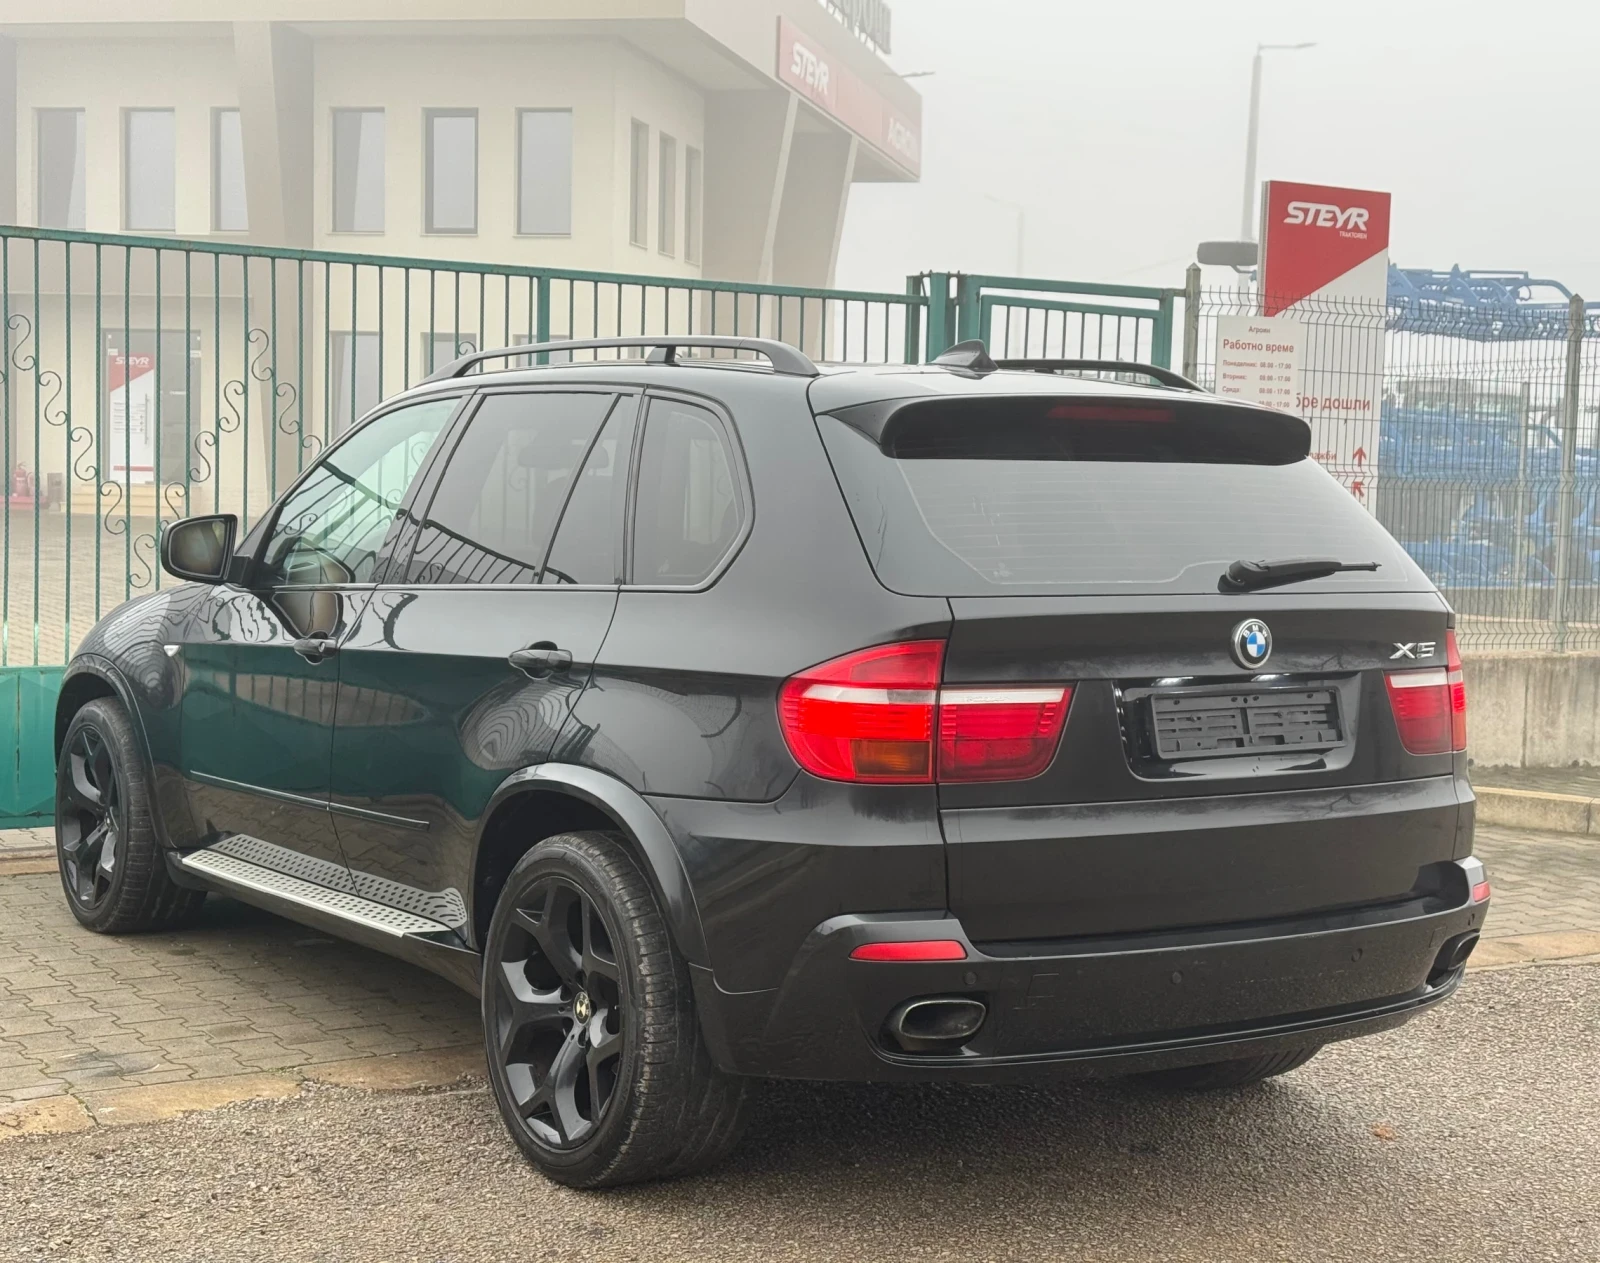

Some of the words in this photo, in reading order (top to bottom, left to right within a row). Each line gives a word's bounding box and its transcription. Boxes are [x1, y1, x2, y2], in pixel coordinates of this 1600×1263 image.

[790, 41, 830, 95] STEYR
[1283, 201, 1370, 231] STEYR
[1339, 230, 1368, 240] TRAKTOREN
[1223, 338, 1263, 351] Работно
[1265, 343, 1294, 354] време
[1322, 397, 1371, 411] дошли
[1389, 641, 1436, 660] X5
